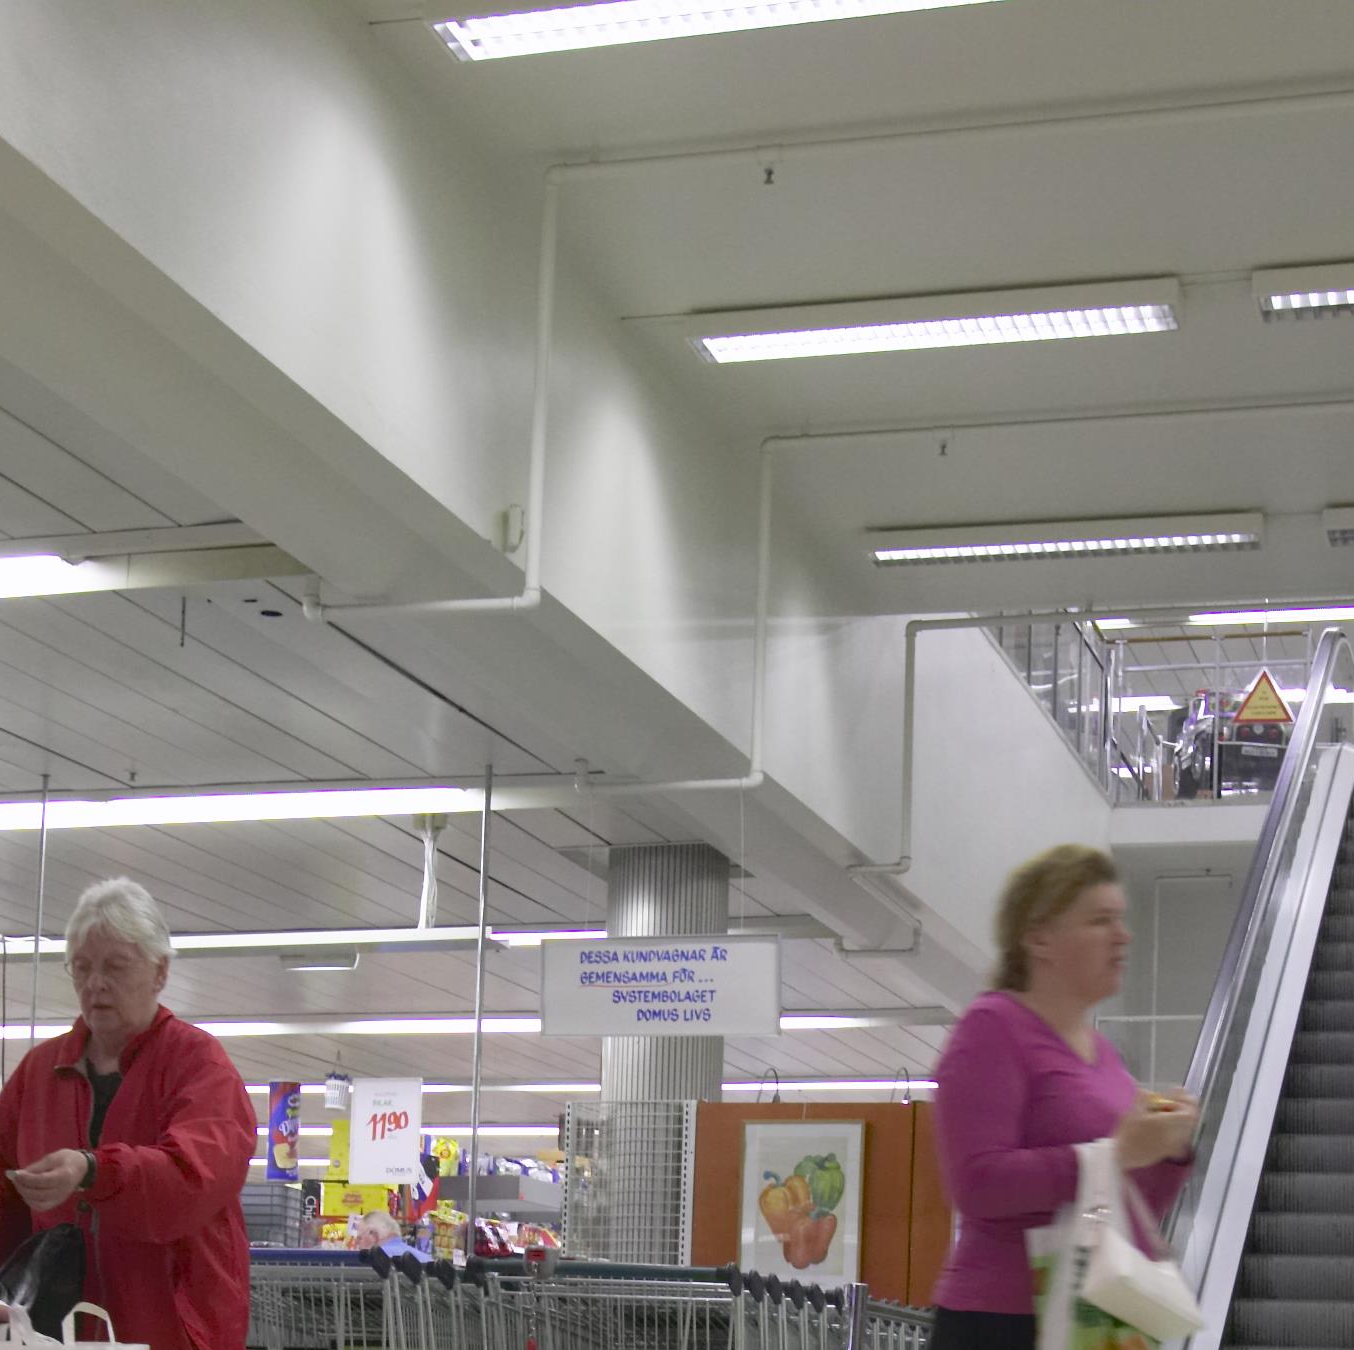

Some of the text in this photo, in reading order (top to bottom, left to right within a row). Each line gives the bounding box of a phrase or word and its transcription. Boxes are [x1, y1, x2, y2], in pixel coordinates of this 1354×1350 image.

[580, 950, 619, 964] DESSA
[622, 949, 706, 963] KUNDVAGNAR
[580, 971, 668, 984] GEMENSAMMA
[612, 990, 717, 1003] SYSTEMBOLAGET
[636, 1008, 711, 1022] DOMUS LIVS
